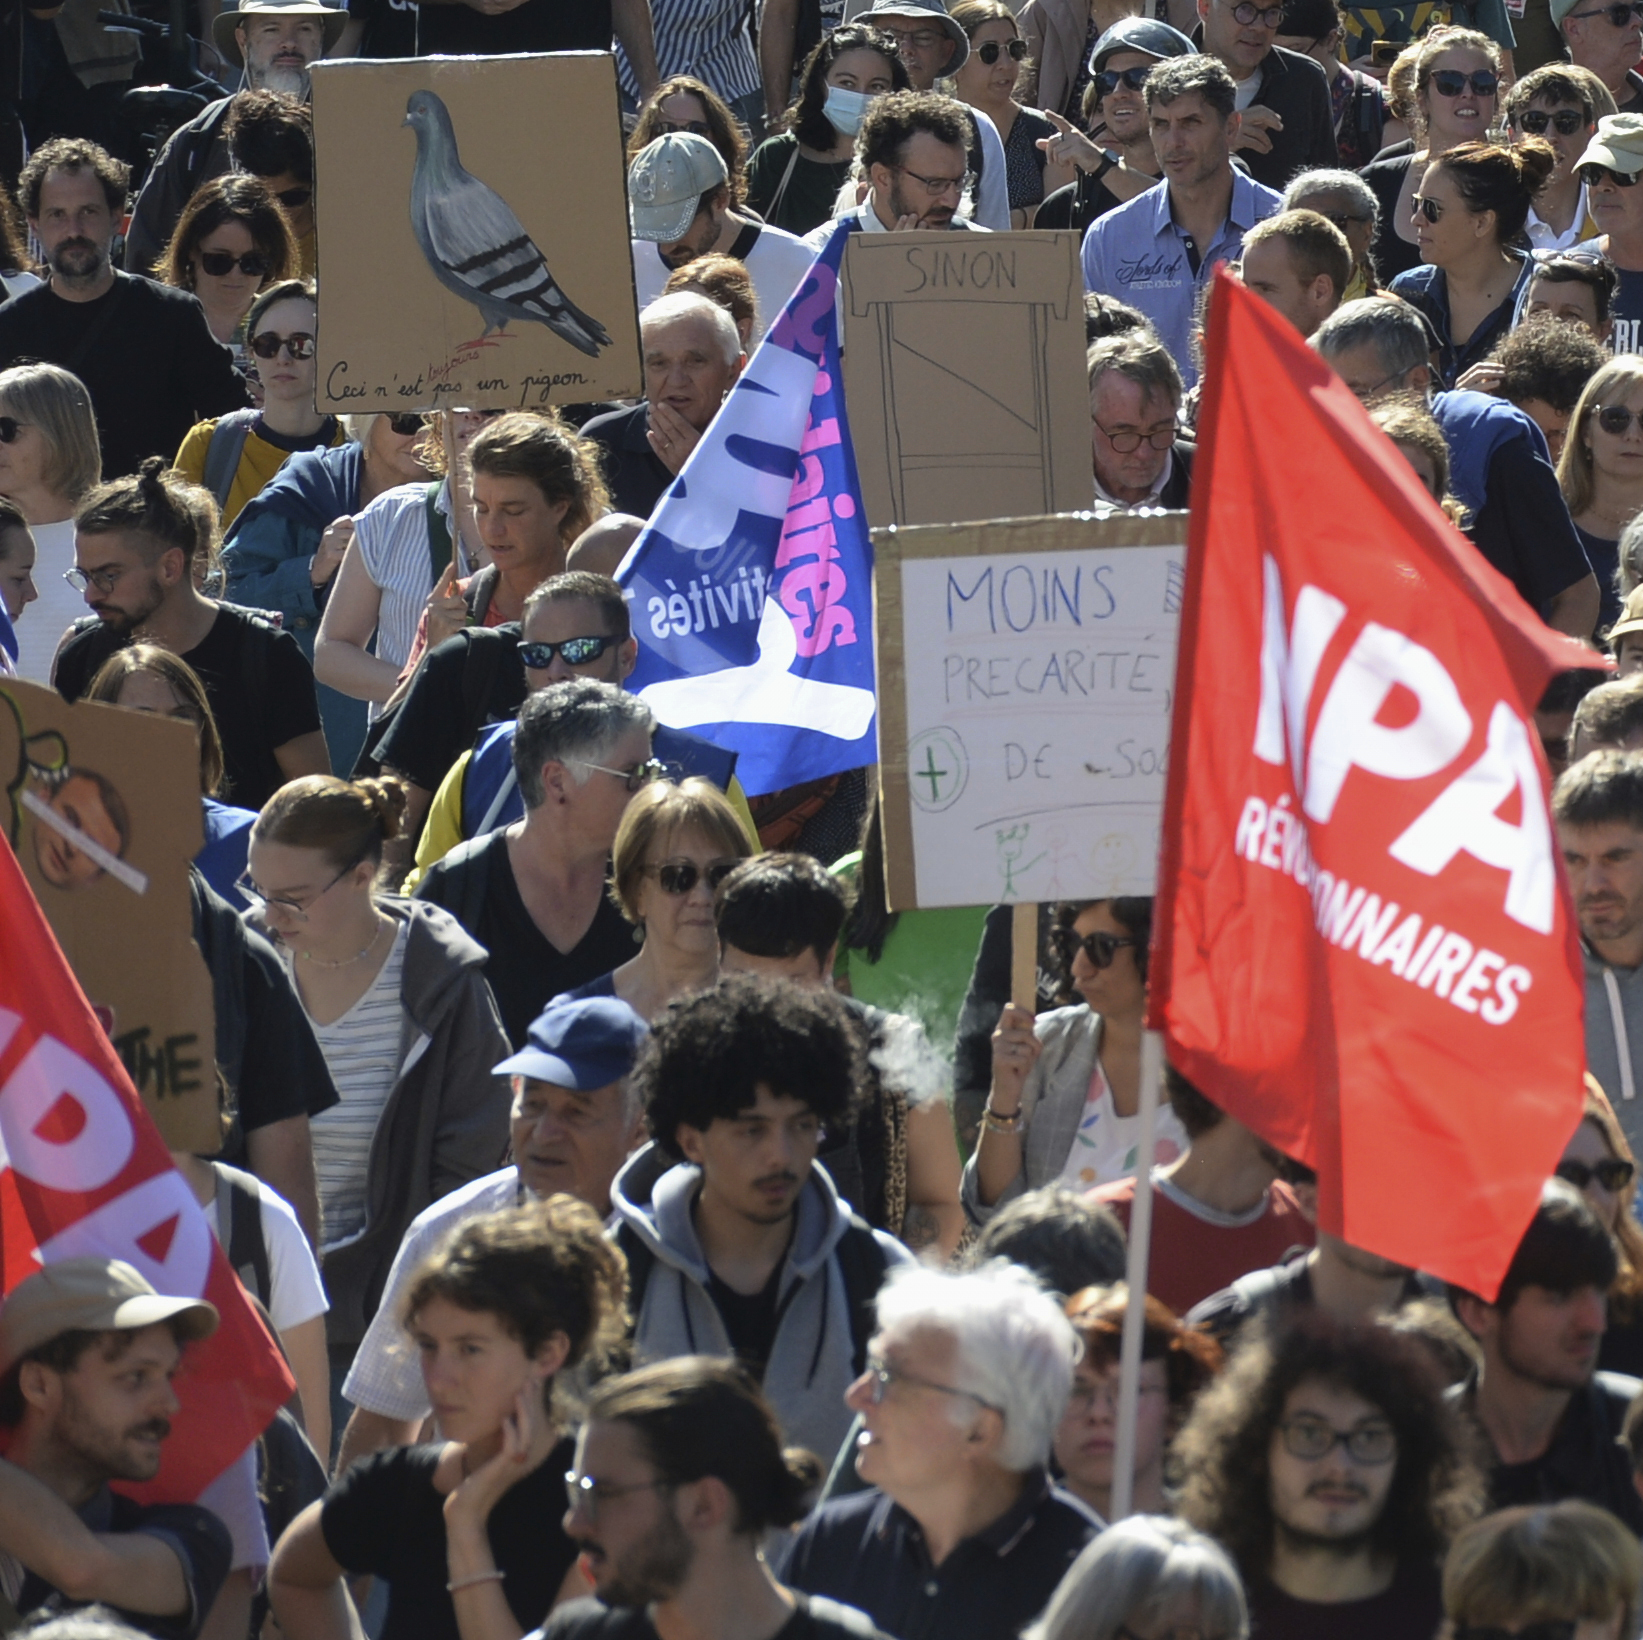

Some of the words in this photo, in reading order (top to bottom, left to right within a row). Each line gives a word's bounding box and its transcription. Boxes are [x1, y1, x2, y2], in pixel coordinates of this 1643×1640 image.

[903, 249, 1018, 292] SINON
[1115, 252, 1164, 285] Lords
[1163, 254, 1183, 281] of
[326, 360, 367, 402] Ceci
[374, 374, 425, 398] n'est
[431, 380, 463, 411] pas
[476, 374, 510, 391] un
[518, 369, 598, 407] pigeon.
[426, 350, 481, 385] toujours
[945, 563, 1119, 634] MOINS
[1003, 740, 1053, 781] DE
